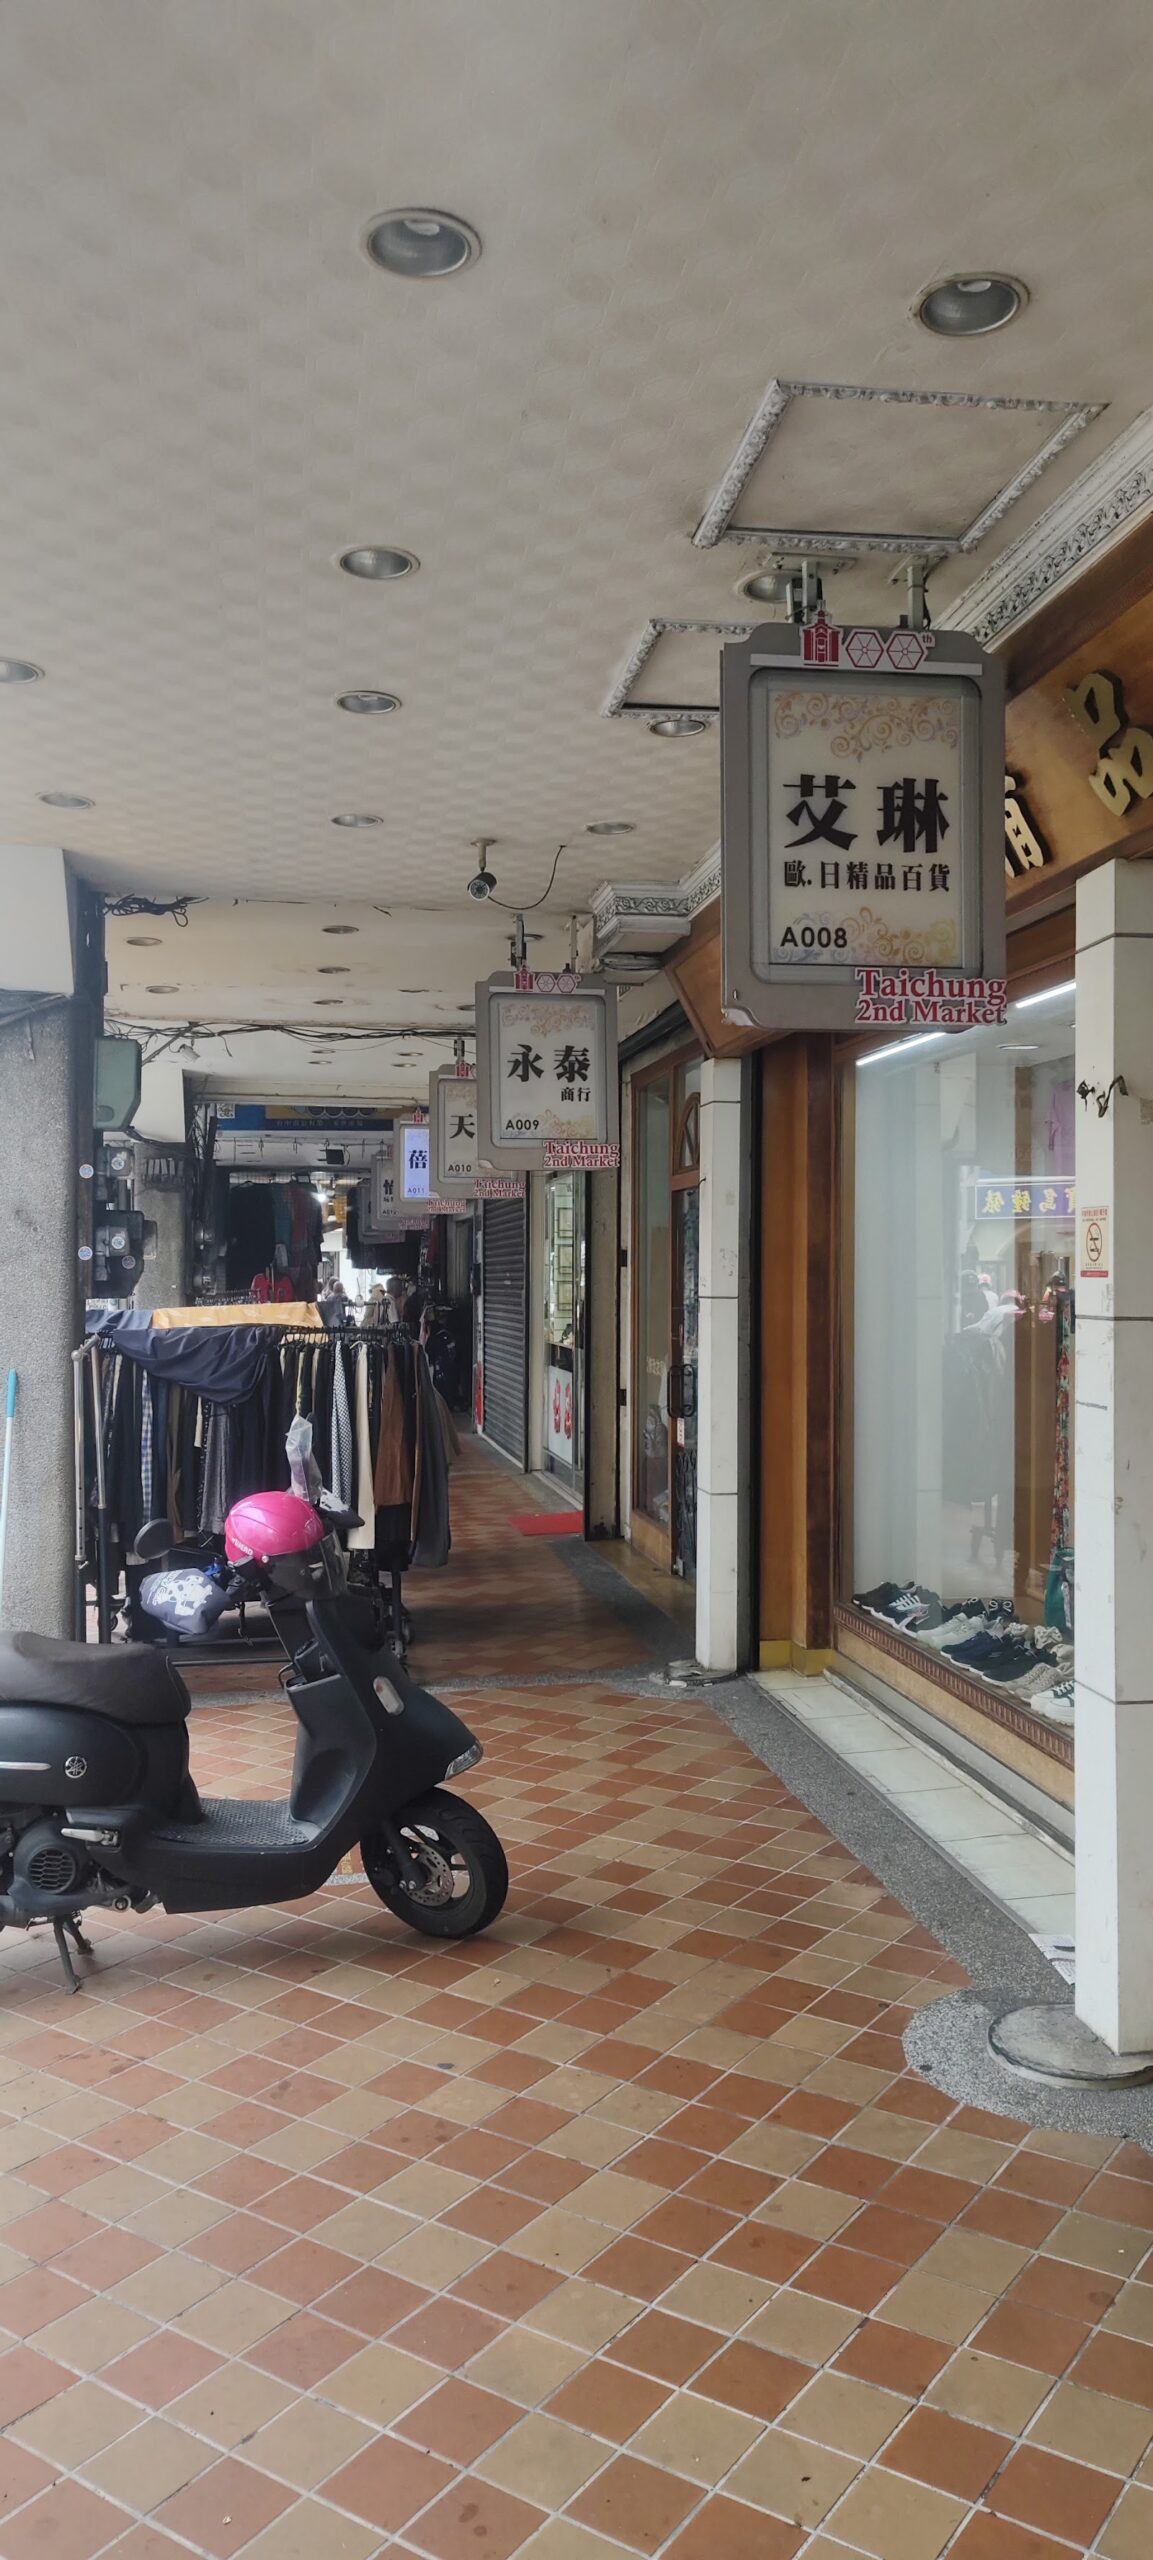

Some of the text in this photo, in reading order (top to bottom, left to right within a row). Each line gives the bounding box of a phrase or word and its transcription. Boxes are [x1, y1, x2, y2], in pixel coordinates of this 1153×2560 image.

[783, 774, 950, 853] 艾琳
[780, 926, 848, 948] A008
[857, 969, 1005, 1000] Taichung
[856, 1000, 1005, 1025] 2nd Market
[507, 1044, 591, 1083] 永泰
[561, 1087, 591, 1102] 商行
[450, 1114, 475, 1139] 天
[505, 1120, 540, 1131] A009
[544, 1141, 619, 1158] Taichung
[447, 1164, 472, 1173] A010
[544, 1156, 619, 1168] 2nd Market
[474, 1179, 526, 1191] Taichung
